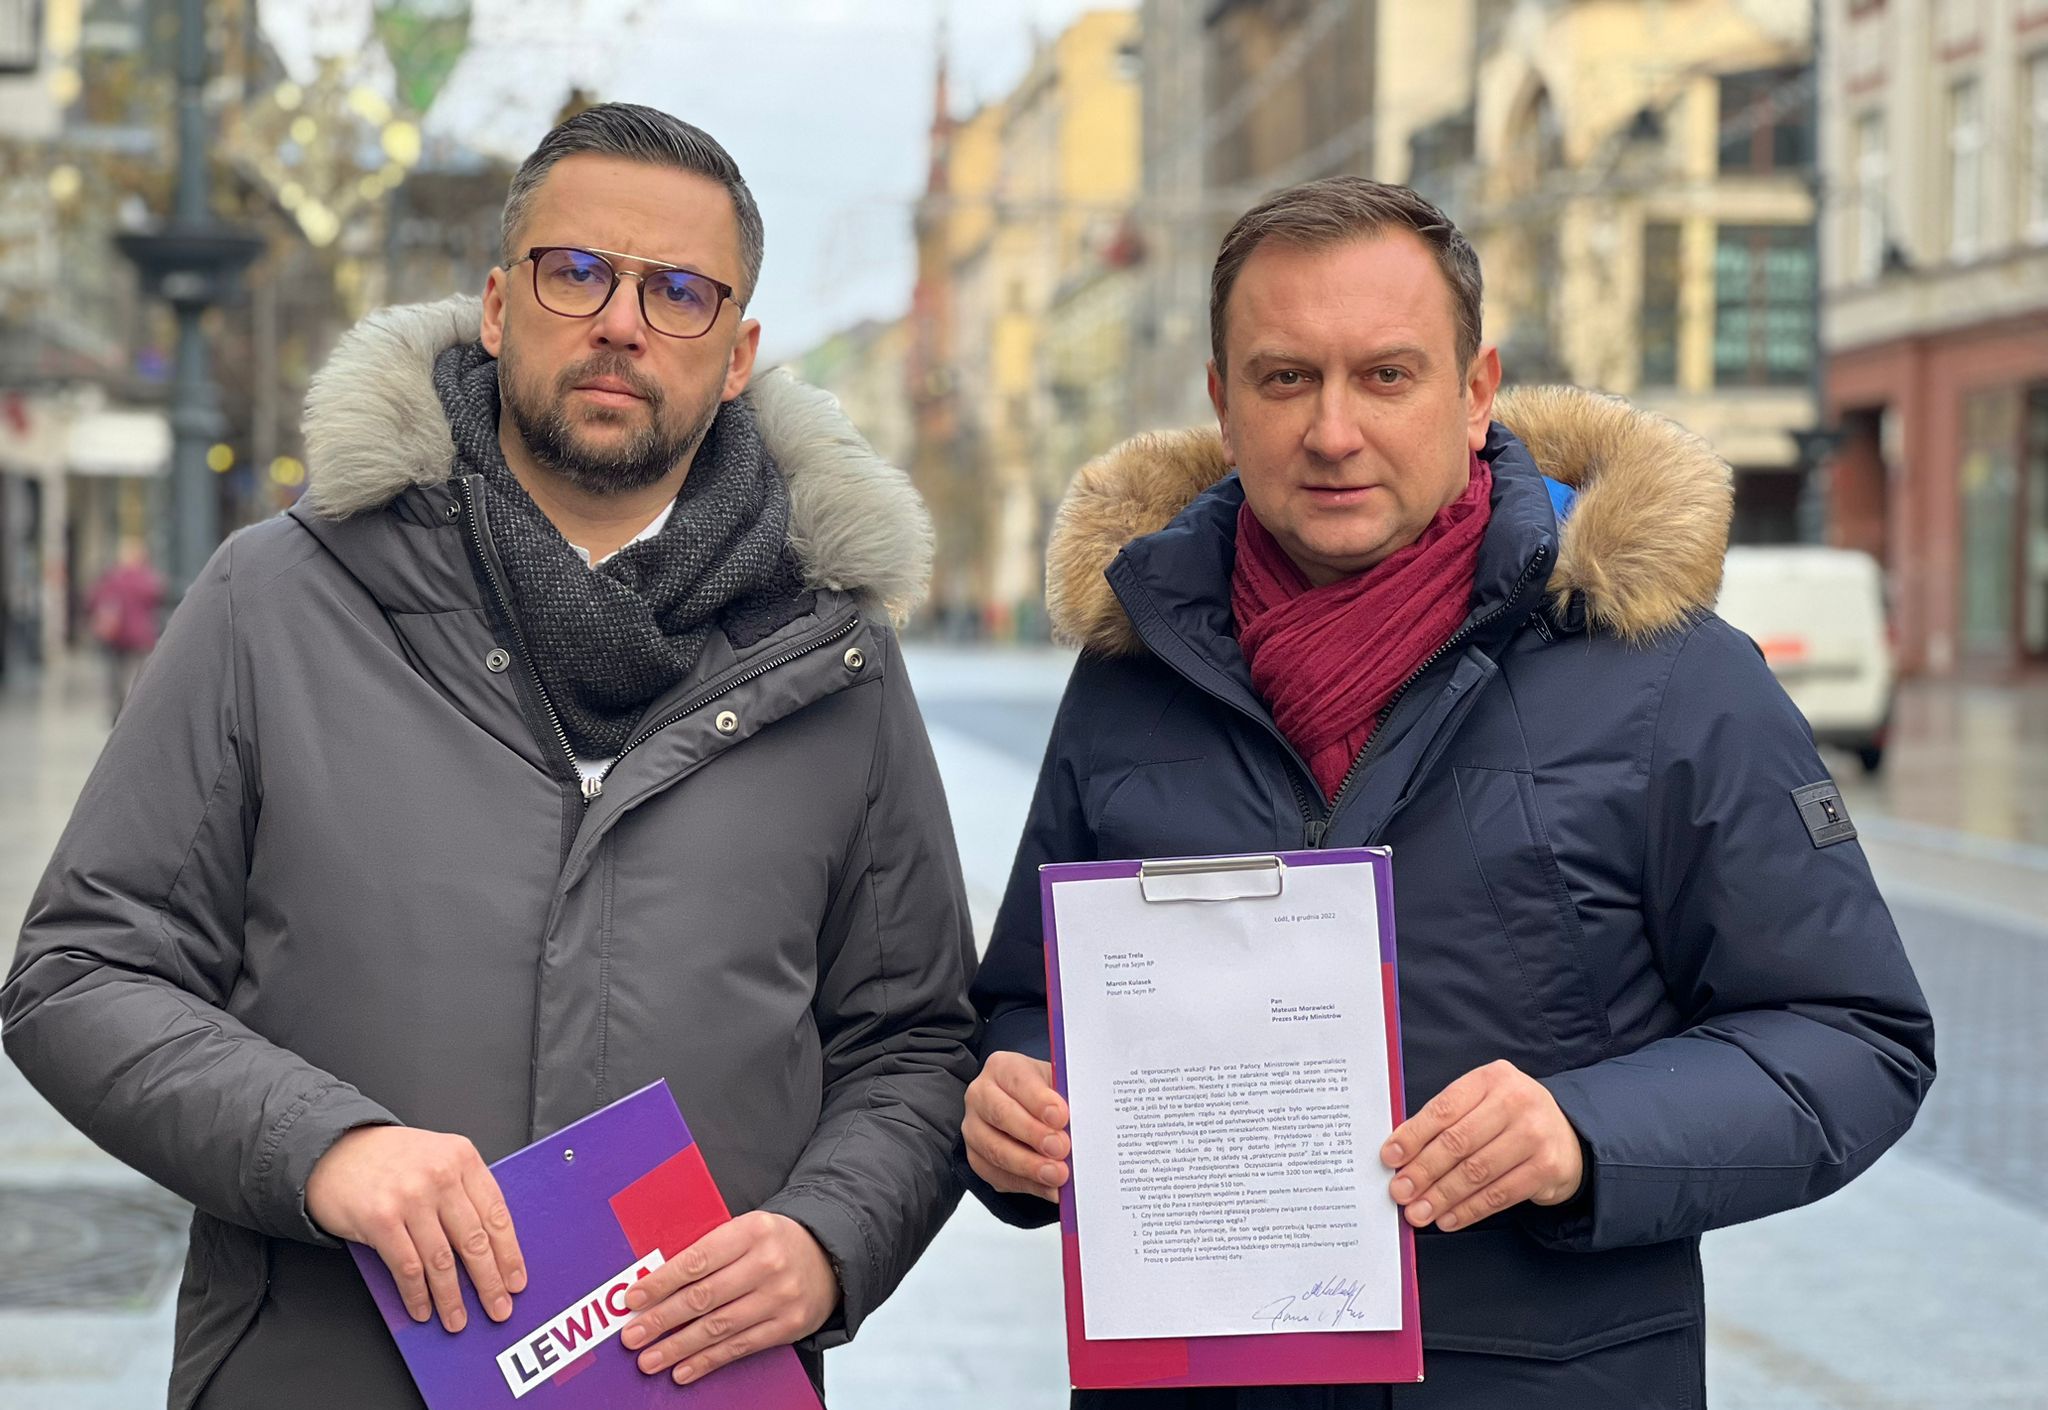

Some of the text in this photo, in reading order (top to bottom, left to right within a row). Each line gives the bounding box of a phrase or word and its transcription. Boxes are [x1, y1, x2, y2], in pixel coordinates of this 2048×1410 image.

[1296, 913, 1320, 923] grudnia
[1320, 912, 1336, 920] 2022
[1104, 951, 1144, 960] Tomasz Trela
[1130, 960, 1146, 969] Sejm
[1128, 978, 1152, 986] Kulasek
[1132, 987, 1147, 996] Sejm
[1271, 1003, 1335, 1013] Mateusz Morawiecki
[1293, 1014, 1309, 1023] Rady
[1309, 1012, 1342, 1020] Ministrów
